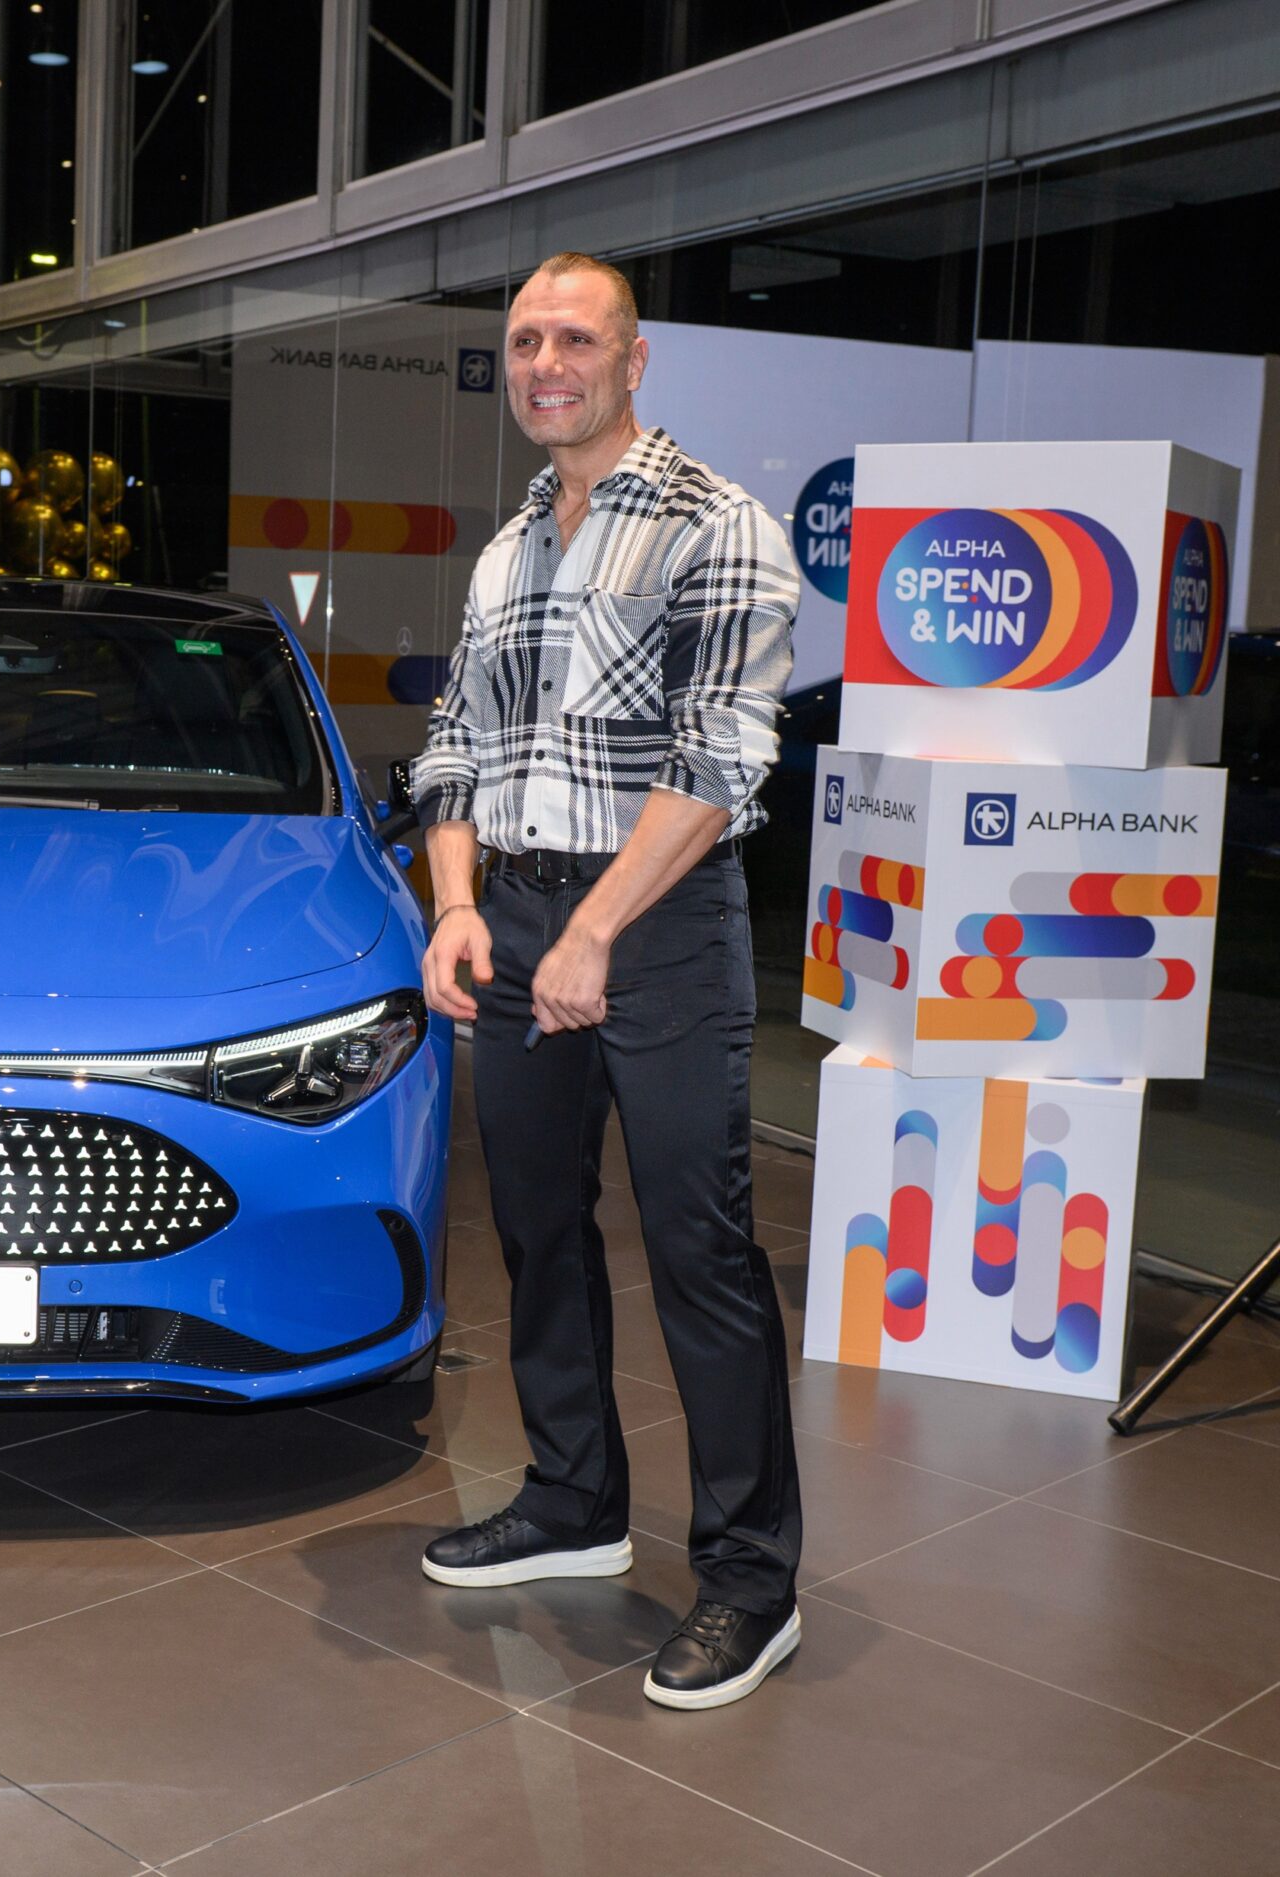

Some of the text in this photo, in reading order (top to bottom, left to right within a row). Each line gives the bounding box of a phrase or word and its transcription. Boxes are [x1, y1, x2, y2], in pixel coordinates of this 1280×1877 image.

[924, 539, 1006, 558] ALPHA
[895, 567, 1033, 605] SPEND
[1172, 575, 1208, 613] SPEND
[910, 608, 1026, 646] & WIN
[846, 794, 917, 823] ALPHA BANK
[1027, 811, 1200, 834] ALPHA BANK
